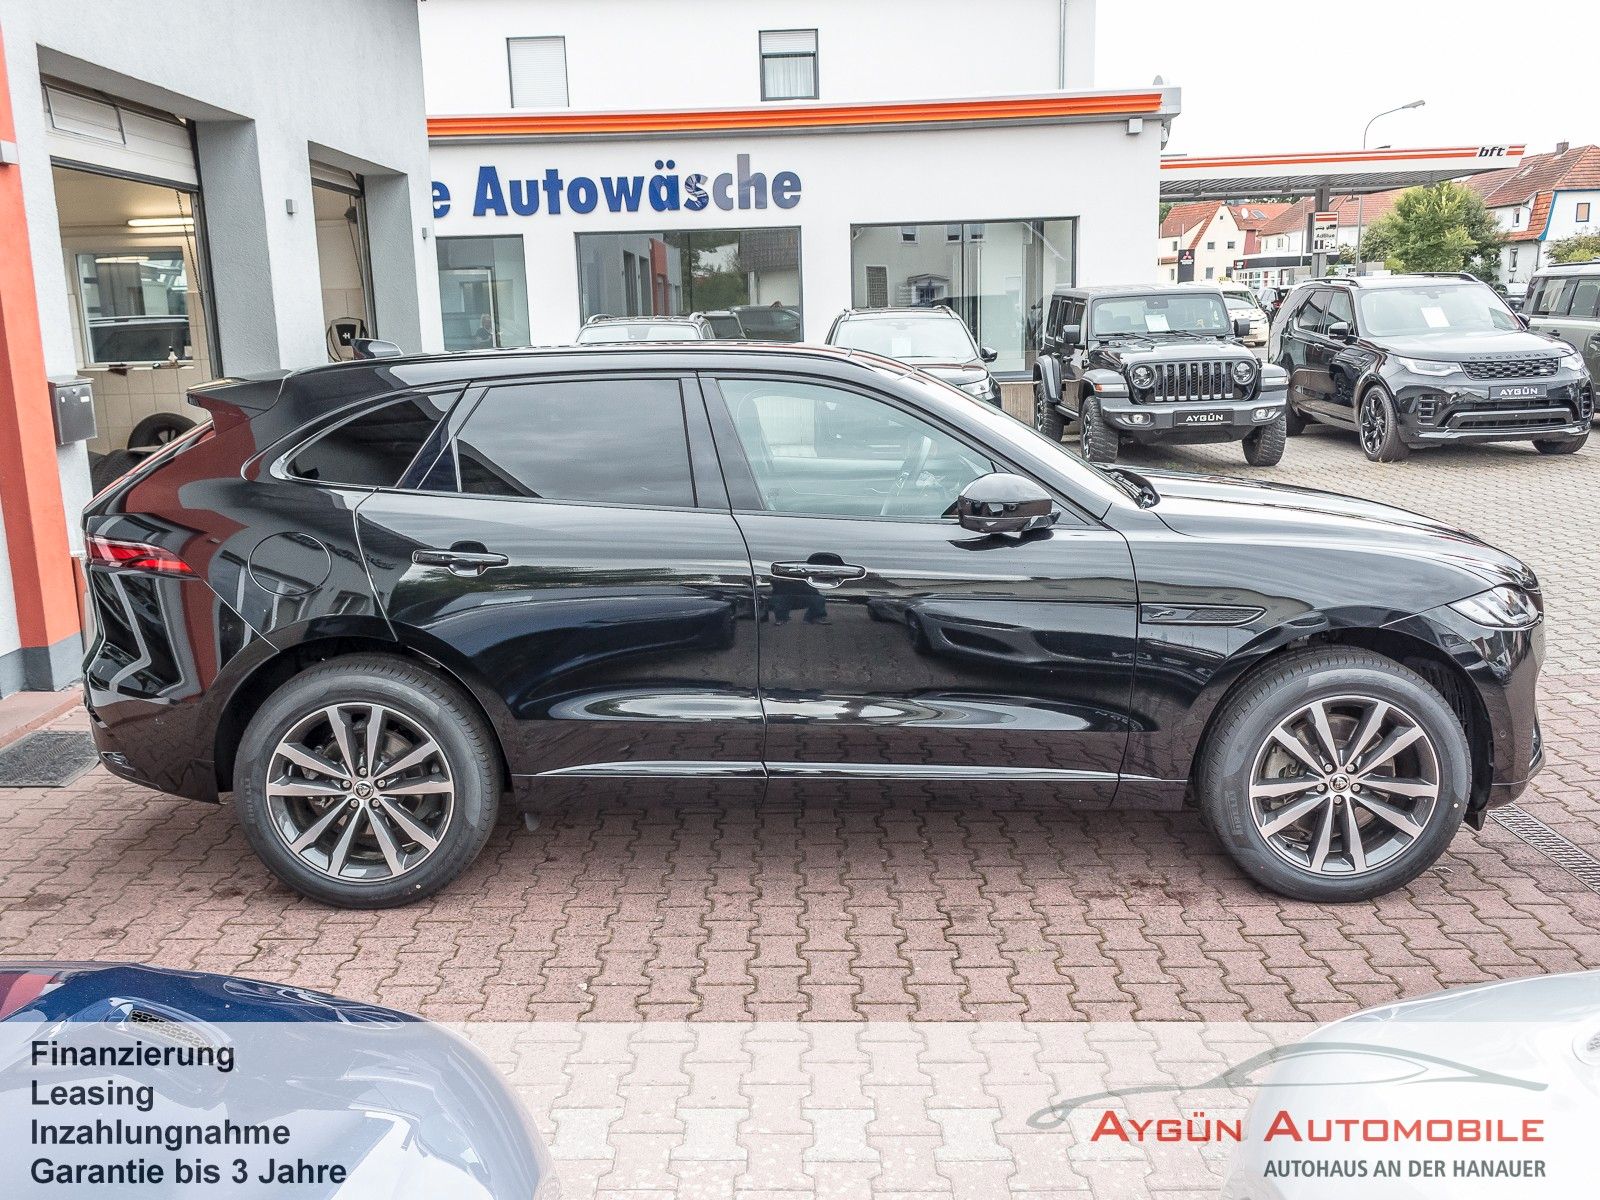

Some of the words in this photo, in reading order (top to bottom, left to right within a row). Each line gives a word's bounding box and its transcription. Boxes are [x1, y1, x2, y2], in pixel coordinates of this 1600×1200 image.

[1478, 146, 1505, 157] bft
[472, 153, 802, 217] Autowäsche
[1499, 386, 1538, 396] AYGÜN
[1185, 412, 1223, 422] AYGÜN
